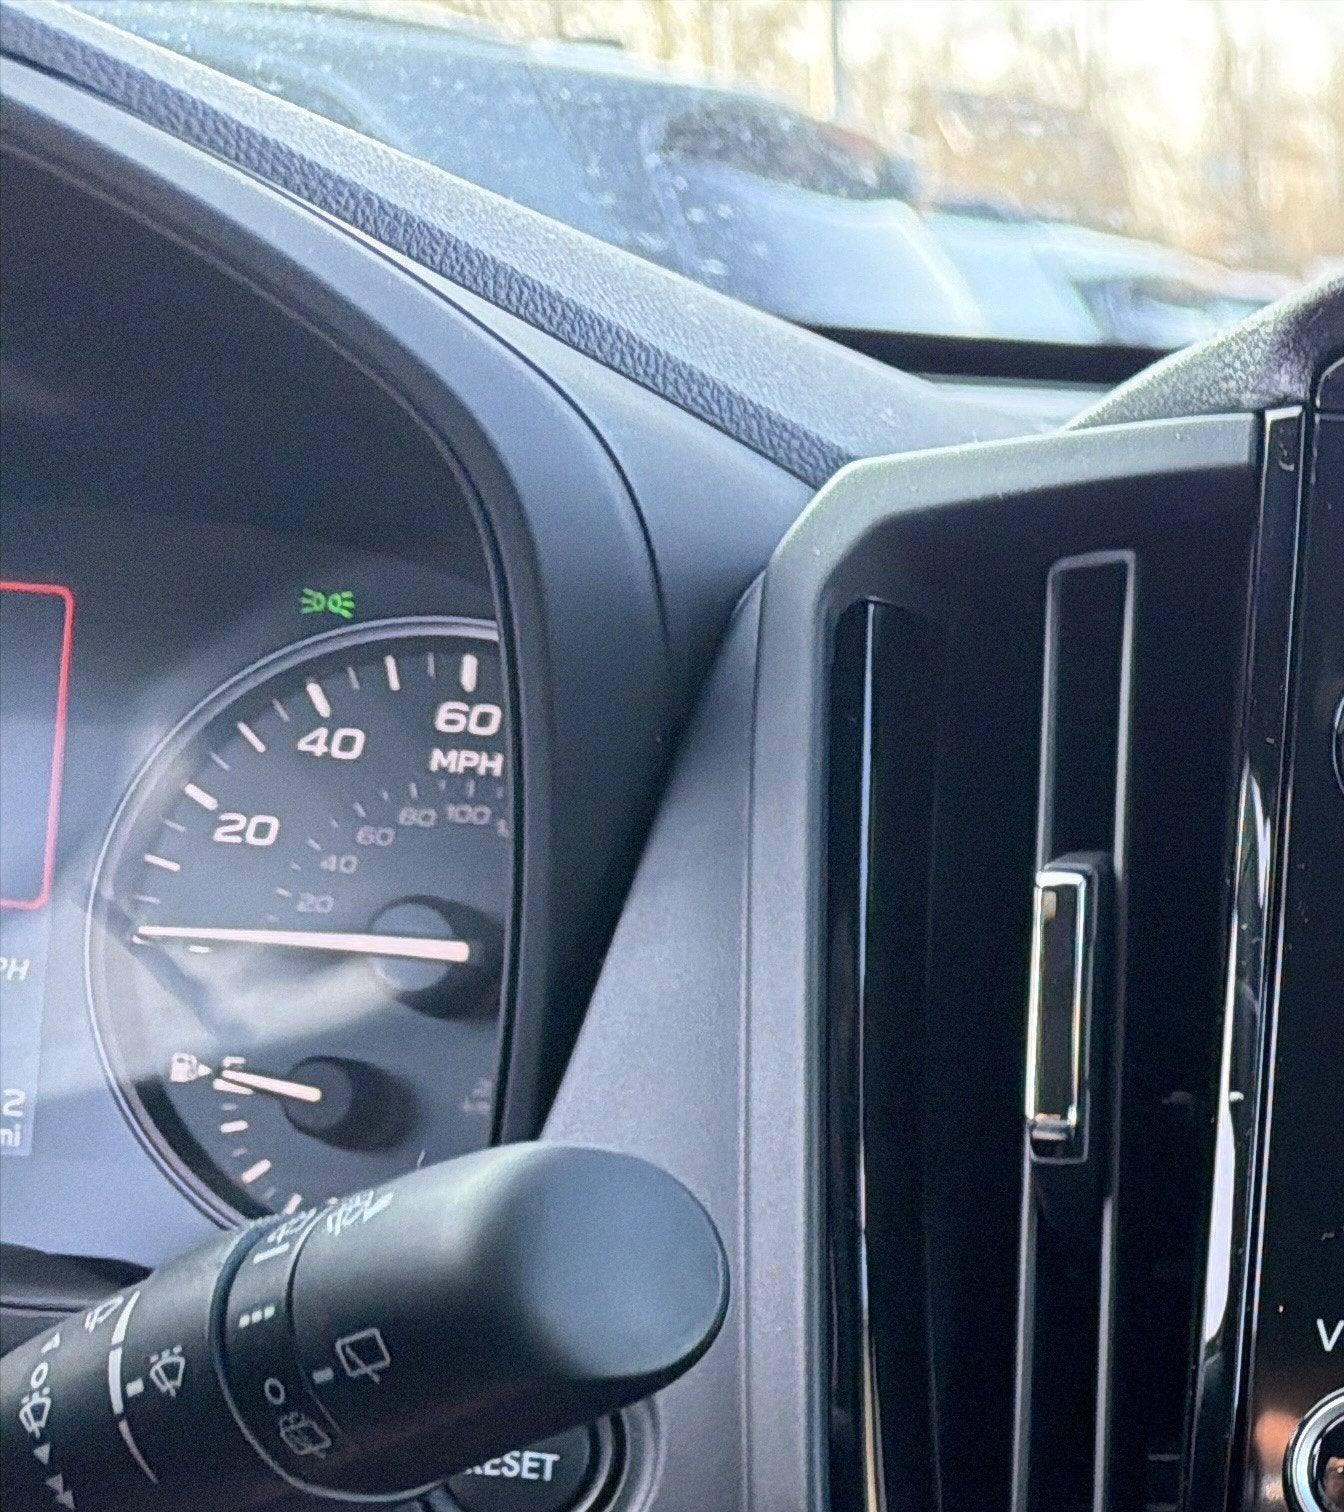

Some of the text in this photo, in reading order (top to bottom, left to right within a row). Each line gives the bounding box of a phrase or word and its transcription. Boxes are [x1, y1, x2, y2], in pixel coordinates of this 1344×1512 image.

[431, 699, 504, 738] 60
[295, 725, 367, 762] 40
[428, 746, 504, 779] MPH
[211, 812, 281, 848] 20
[320, 854, 359, 875] 40
[461, 1448, 562, 1483] ESET
